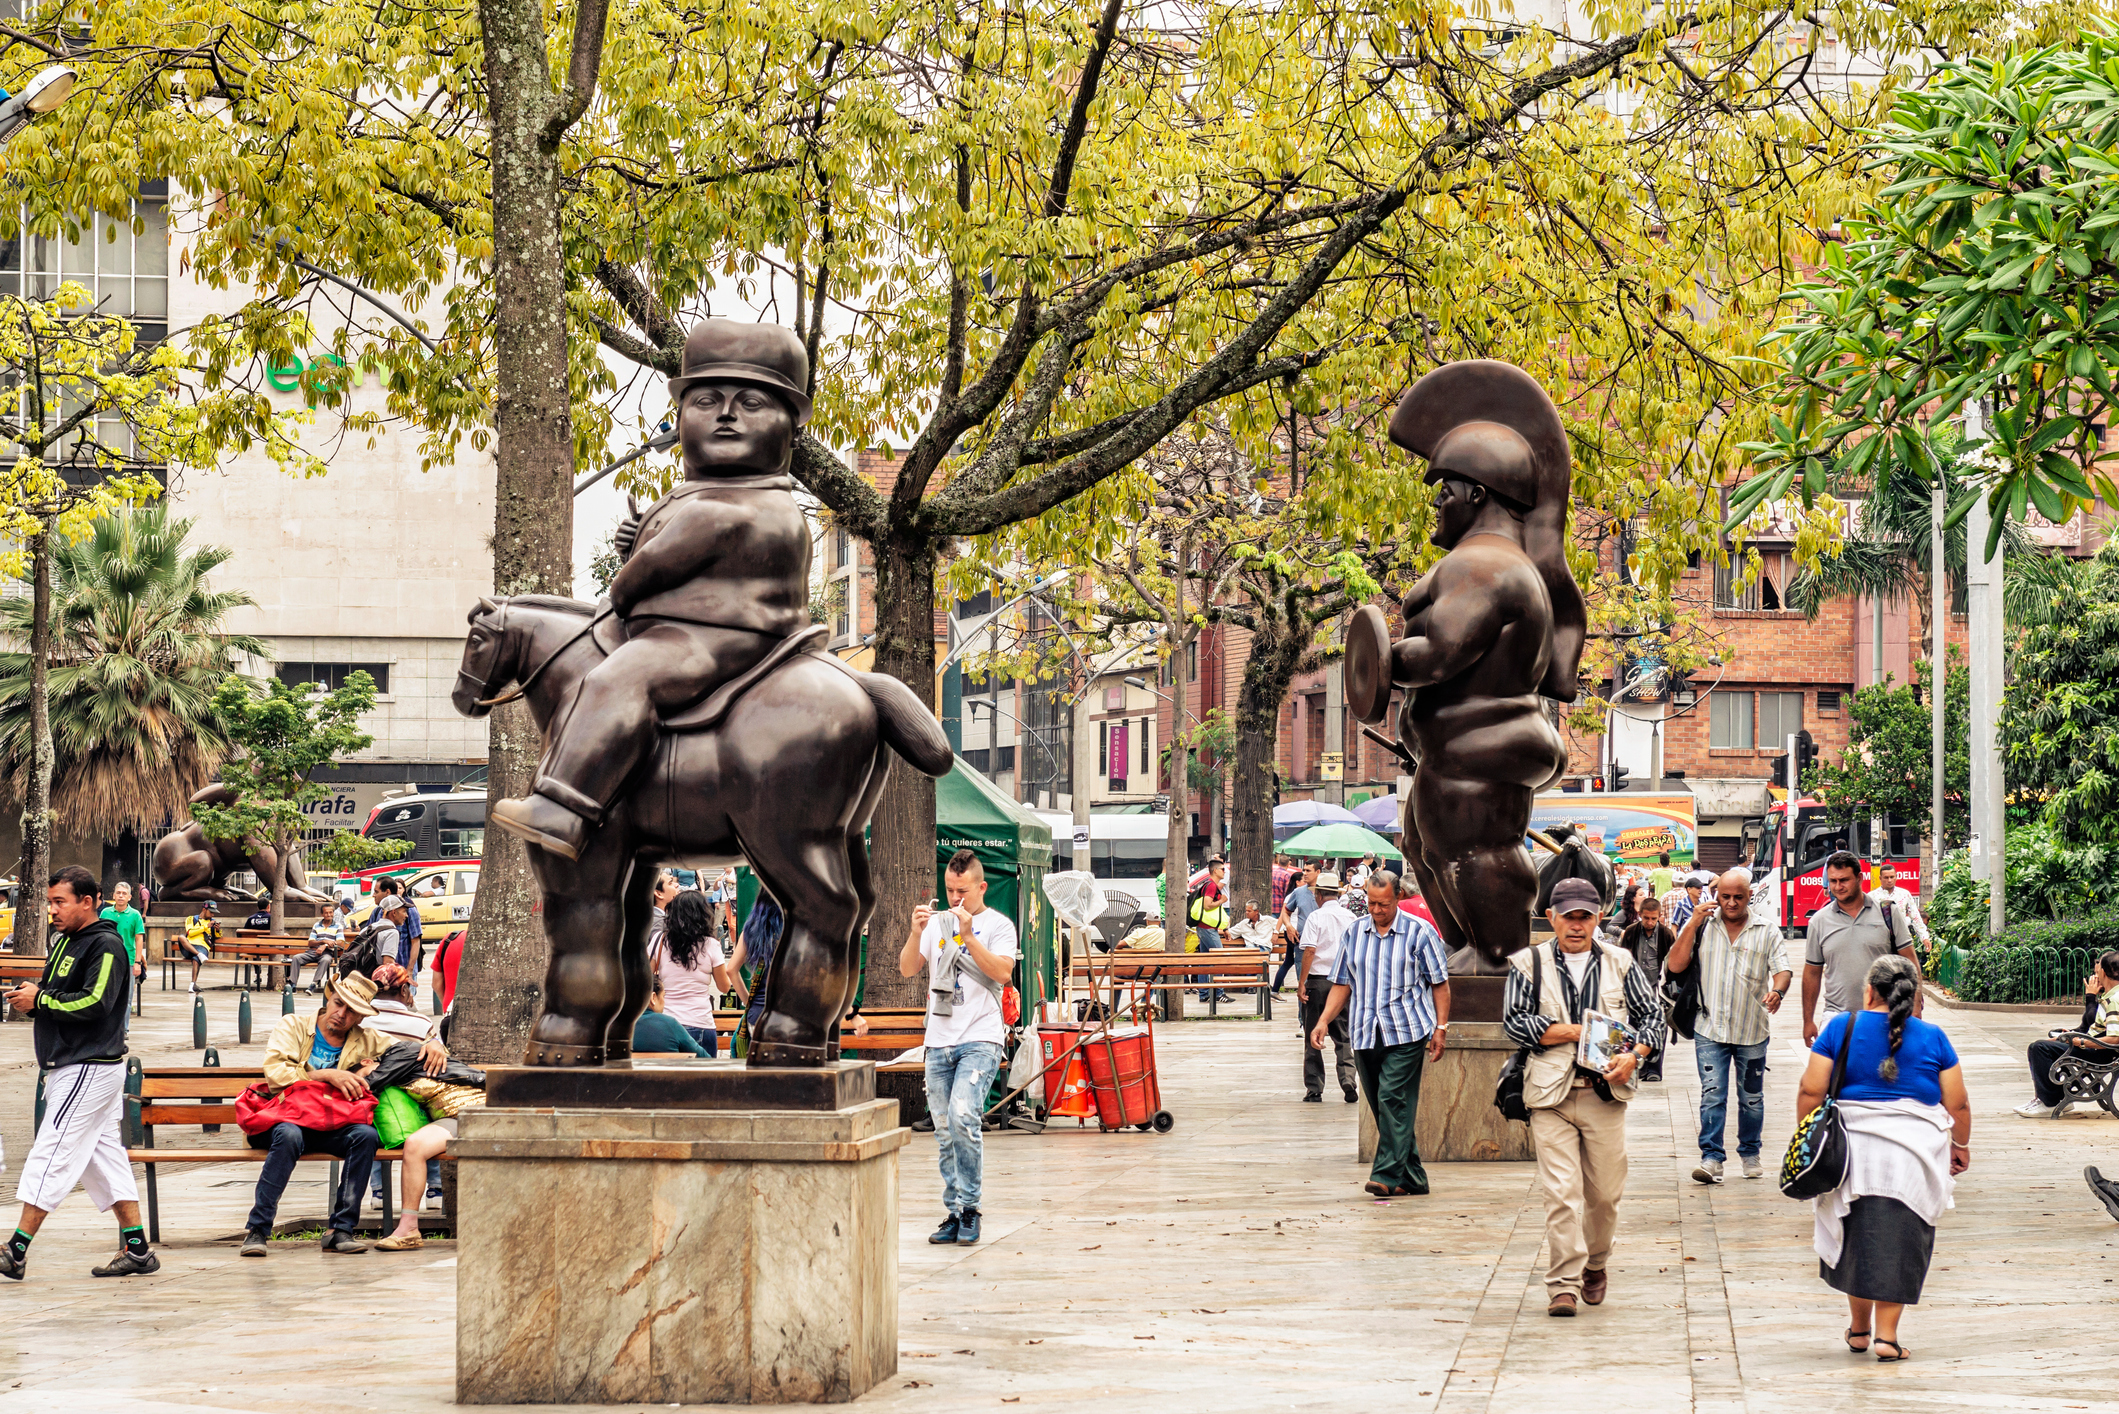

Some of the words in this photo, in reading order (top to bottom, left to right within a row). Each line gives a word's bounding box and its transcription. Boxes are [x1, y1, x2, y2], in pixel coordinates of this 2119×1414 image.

[1629, 687, 1665, 697] SHOW
[324, 818, 355, 827] Facilitar
[1620, 828, 1656, 839] CEREALES
[941, 838, 950, 847] tú
[951, 838, 983, 848] quieres
[1621, 841, 1634, 851] LA
[1633, 834, 1673, 850] DESPENSA
